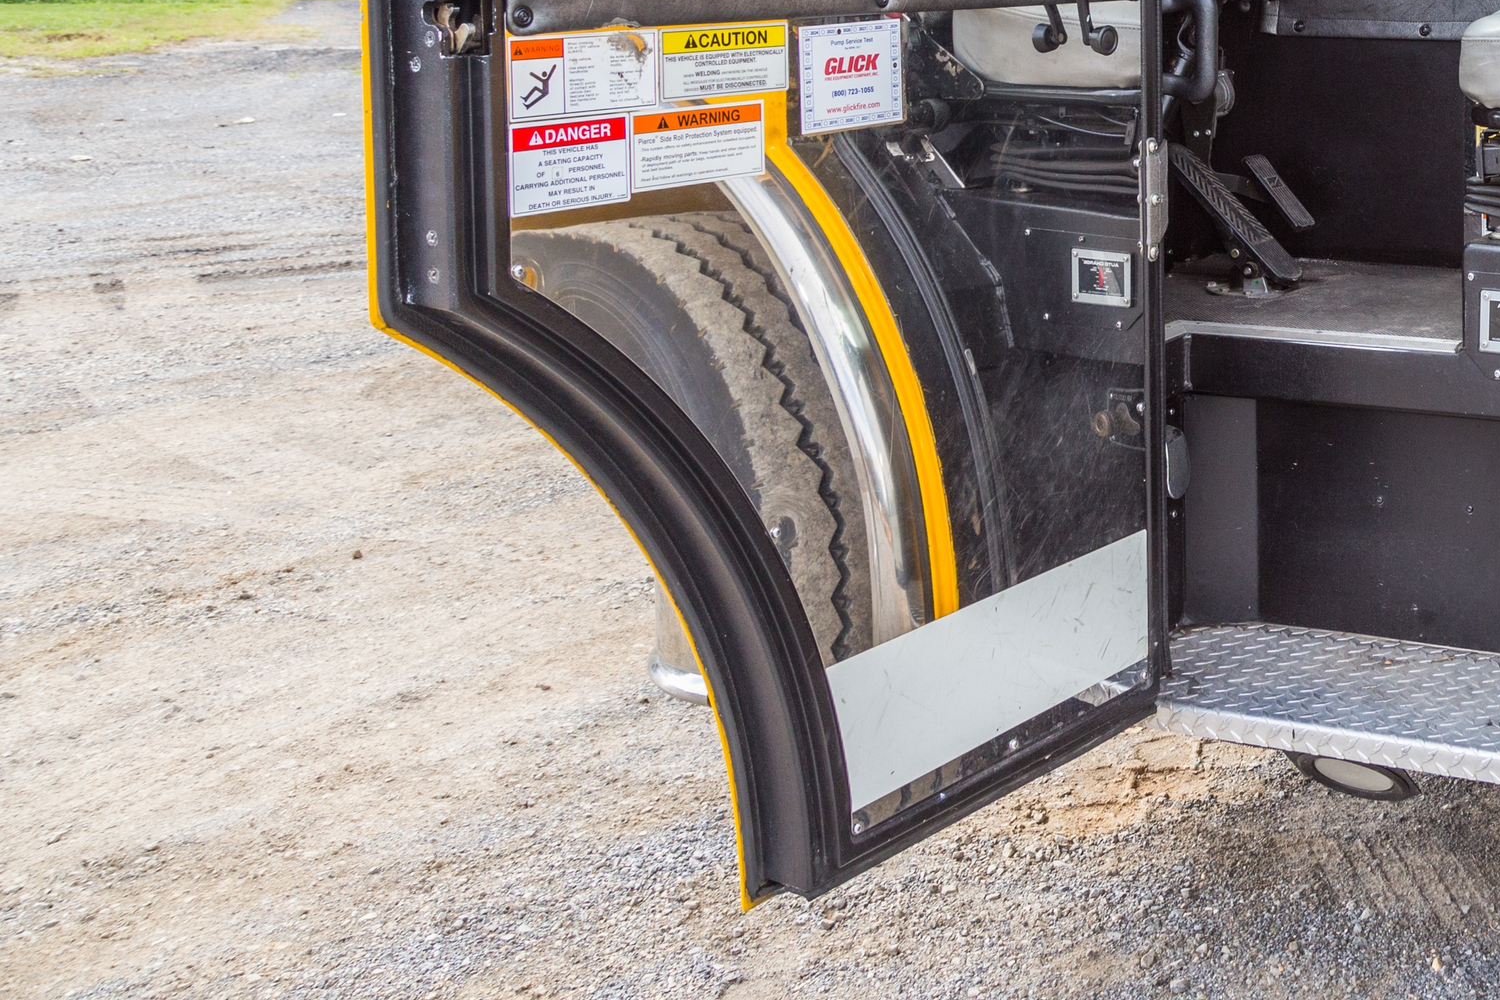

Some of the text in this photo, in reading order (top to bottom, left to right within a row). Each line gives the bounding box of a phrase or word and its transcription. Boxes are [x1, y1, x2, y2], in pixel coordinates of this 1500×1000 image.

[698, 30, 767, 48] CAUTION
[523, 45, 560, 53] WARNING
[744, 49, 783, 57] ELECTRONICALLY
[695, 59, 727, 67] CONTROLLED
[824, 53, 880, 76] GLICK
[832, 86, 874, 98] (800) 723-1055
[827, 102, 881, 113] www.glickfire.com
[677, 109, 740, 127] WARNING
[545, 123, 611, 143] DANGER
[685, 131, 712, 139] Protection
[713, 129, 732, 137] System
[733, 126, 757, 134] equipped.
[544, 158, 572, 166] SEATING
[573, 153, 604, 163] CAPACITY
[568, 163, 605, 173] PERSONNEL
[515, 171, 625, 191] CARRYING ADDITIONAL PERSONNEL
[563, 187, 587, 195] RESULT
[528, 201, 550, 210] DEATH
[562, 197, 590, 205] SERIOUS
